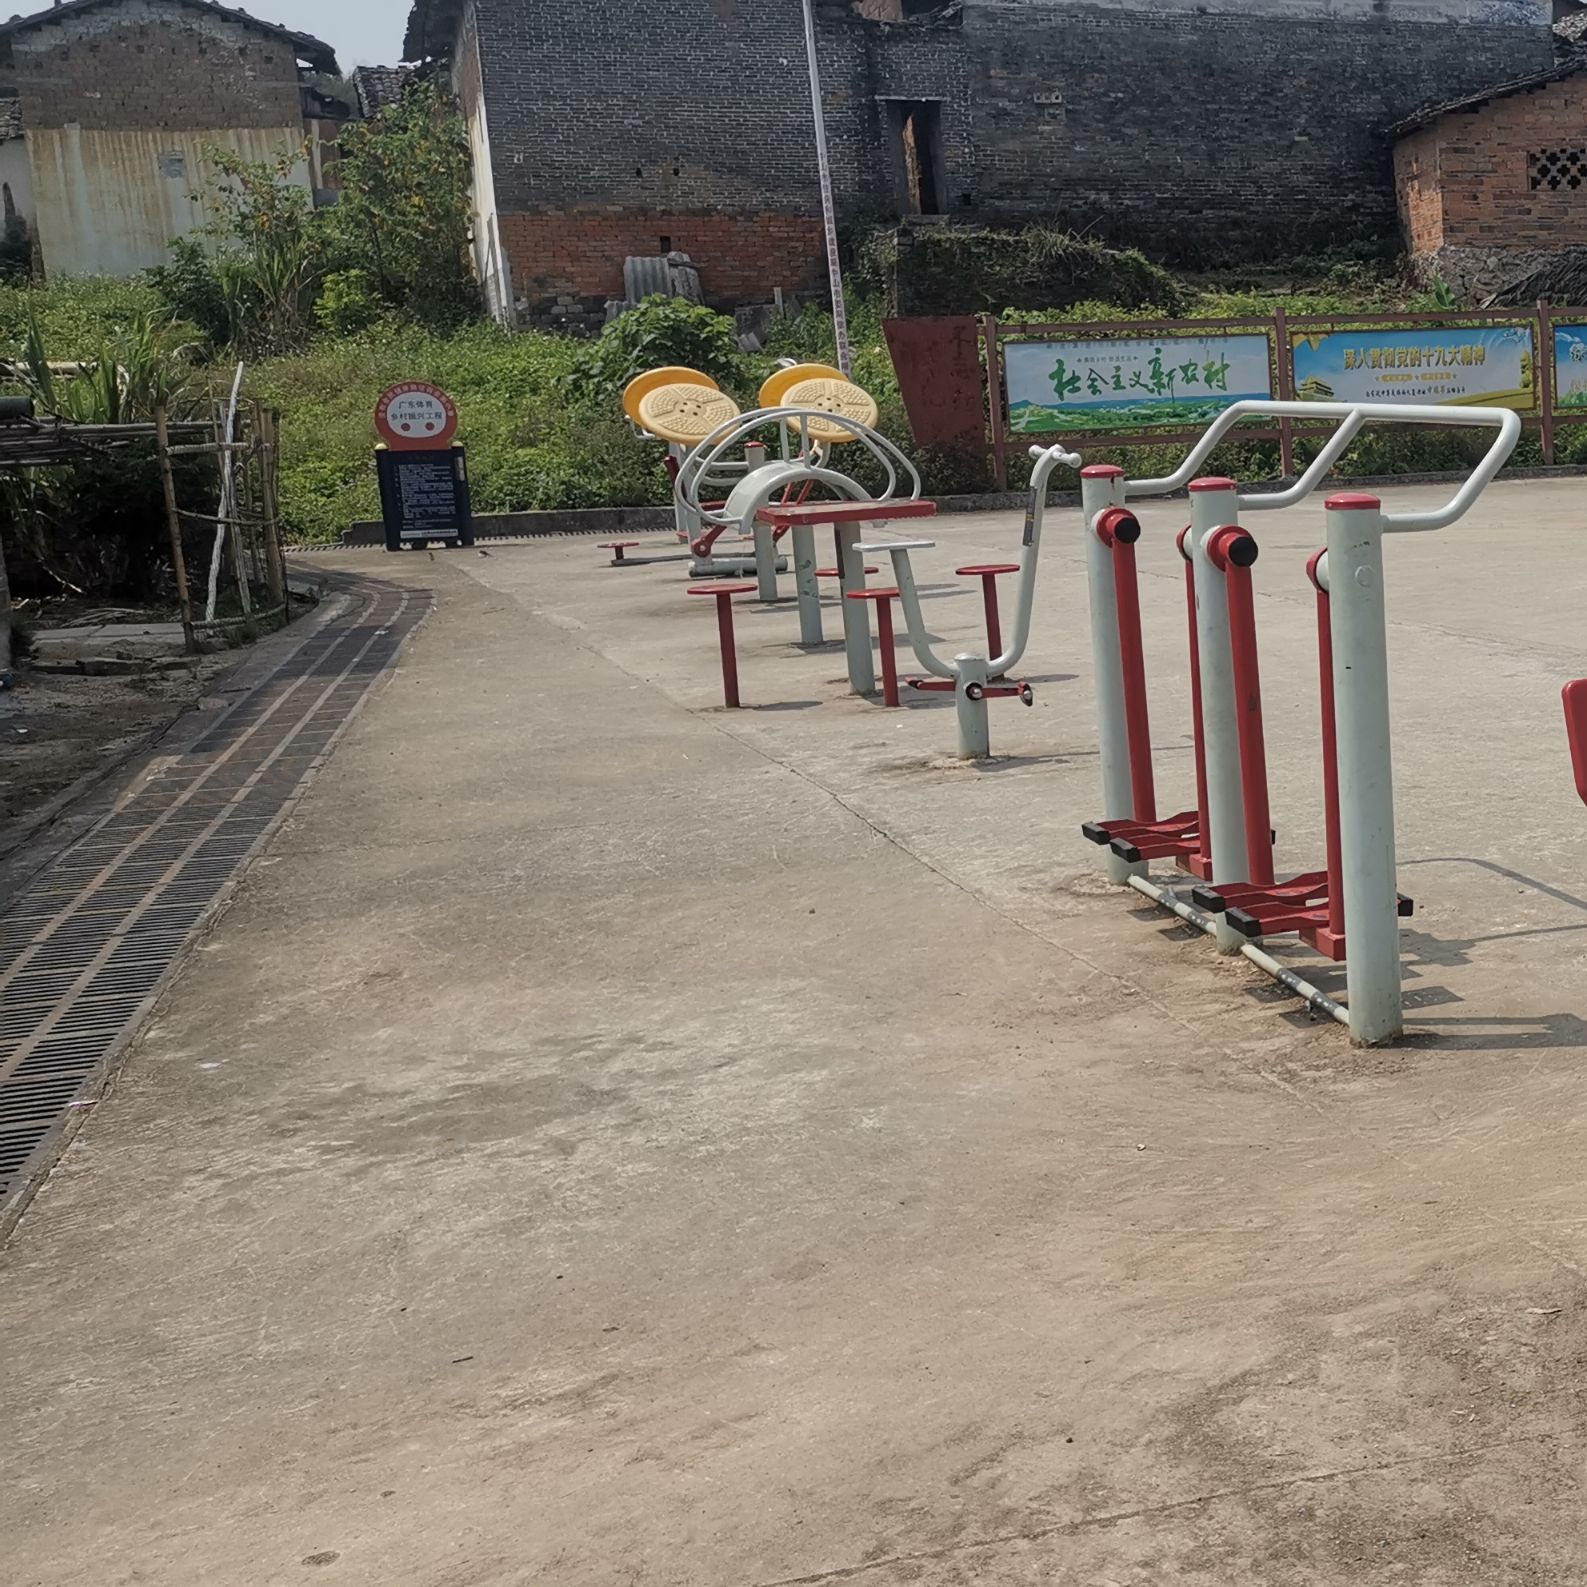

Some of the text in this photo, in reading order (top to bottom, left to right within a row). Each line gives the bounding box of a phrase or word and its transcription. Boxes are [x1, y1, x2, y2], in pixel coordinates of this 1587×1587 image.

[1048, 347, 1231, 404] 社会主义新农村
